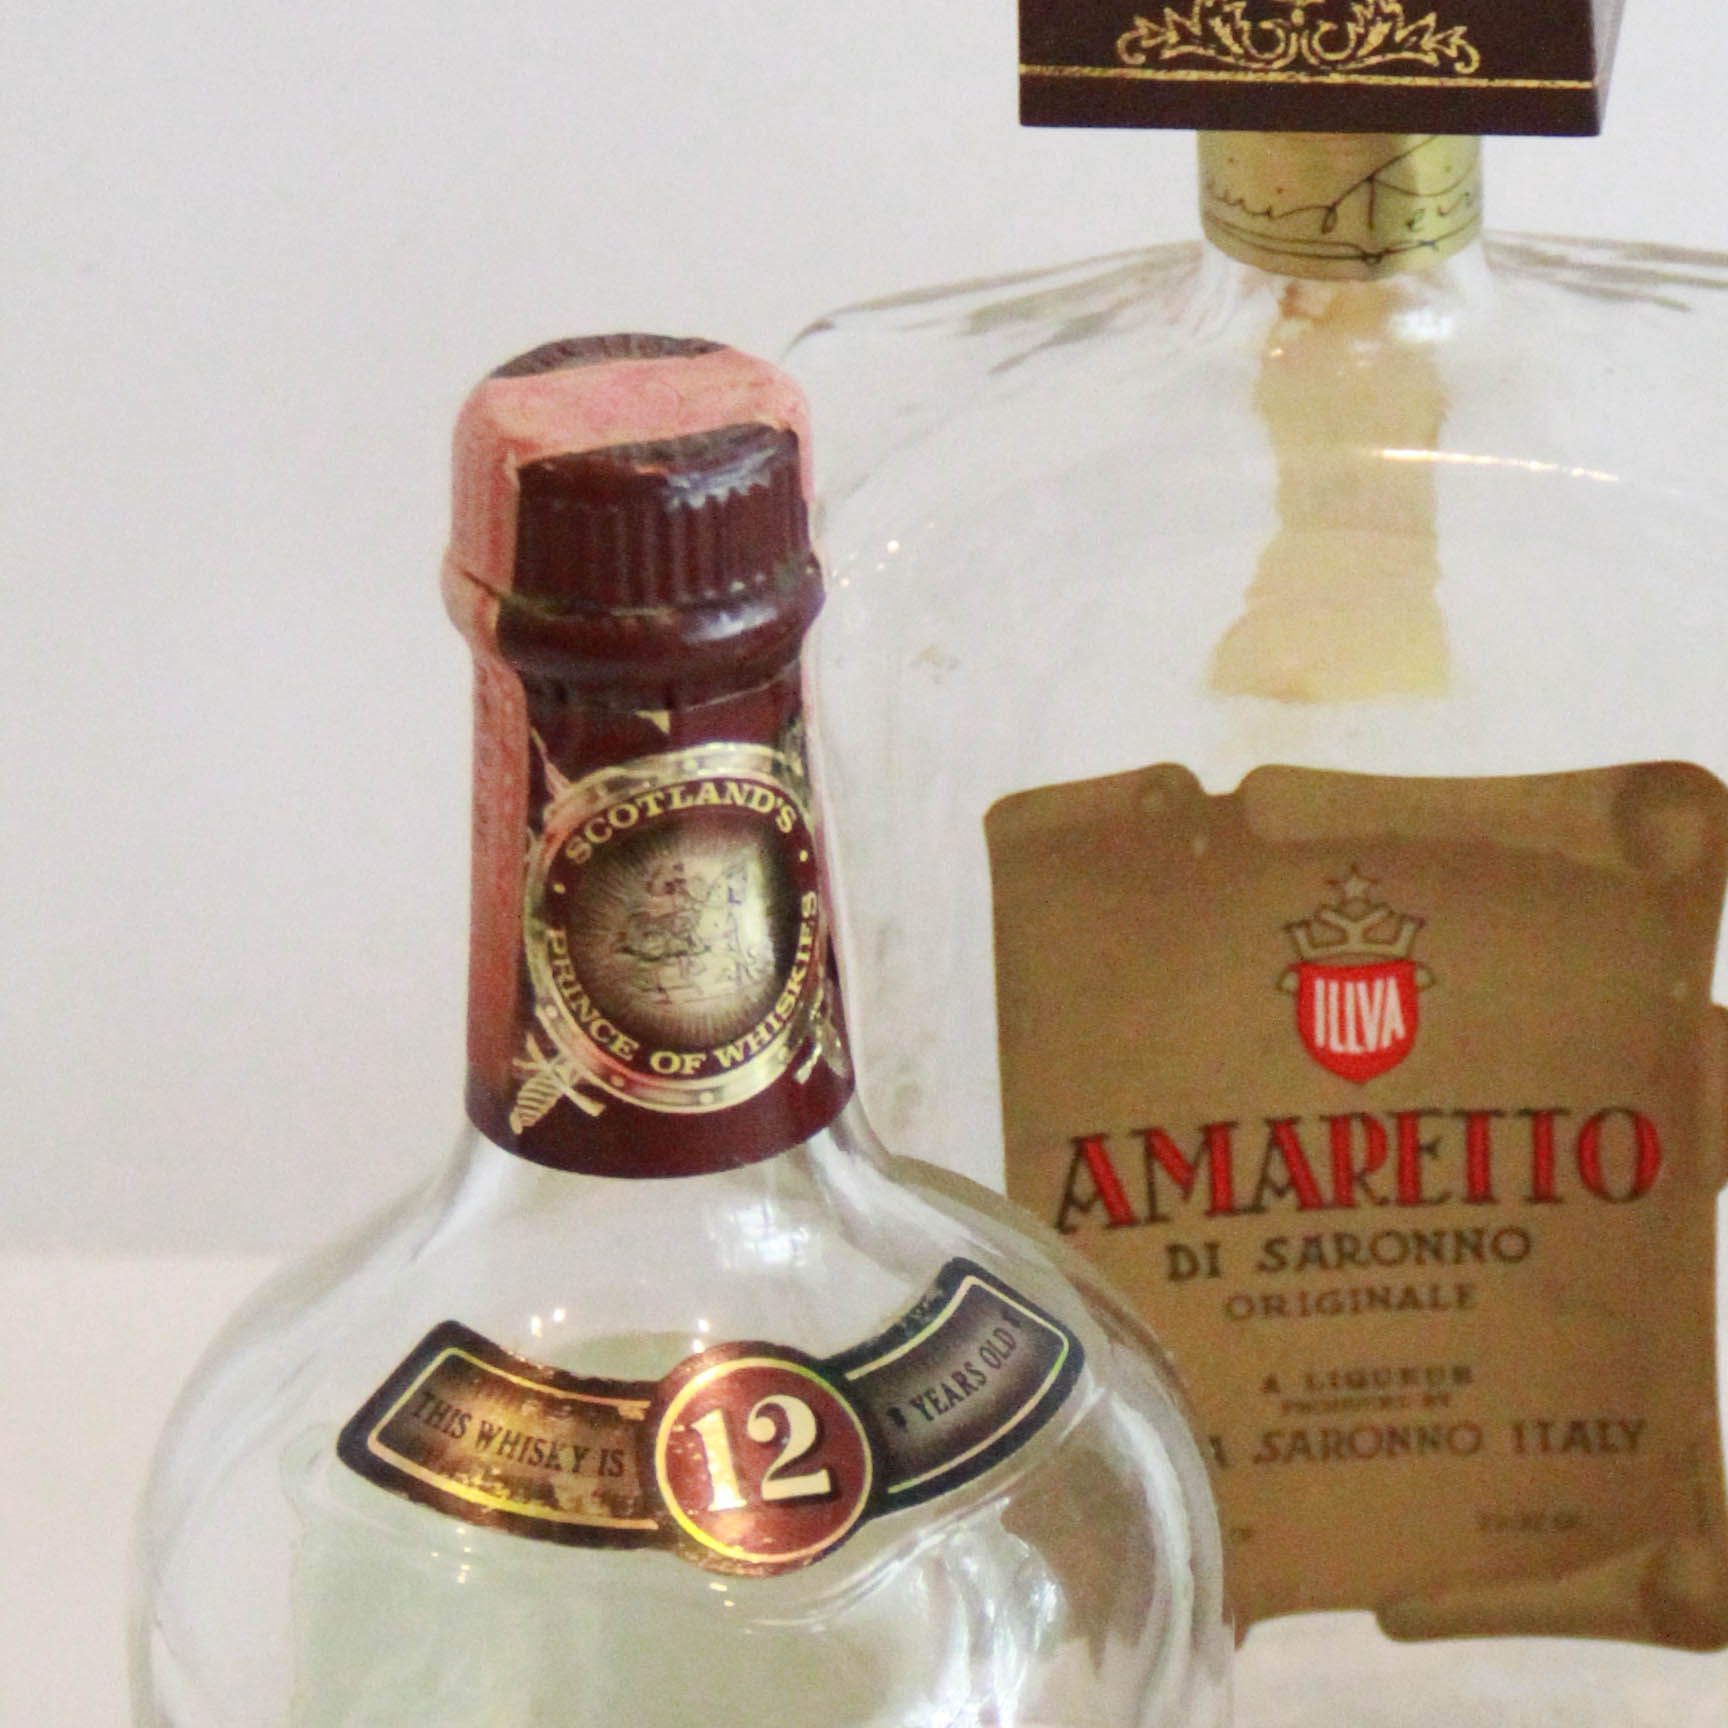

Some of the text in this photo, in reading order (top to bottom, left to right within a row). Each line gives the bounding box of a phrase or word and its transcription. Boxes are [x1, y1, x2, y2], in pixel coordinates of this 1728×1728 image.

[565, 781, 797, 864] SCOTLAND'S
[547, 890, 818, 1074] PRINCE OF WHISKIES
[1055, 1106, 1663, 1234] AMARETTO
[1166, 1225, 1533, 1282] DI SARONNO
[1224, 1285, 1477, 1322] ORIGINALE
[909, 1327, 1017, 1421] YEARS OLD
[411, 1391, 627, 1478] THIS WHISKY IS
[690, 1393, 833, 1512] 12
[1253, 1419, 1485, 1465] SARONNO
[1513, 1417, 1647, 1454] ITALY
